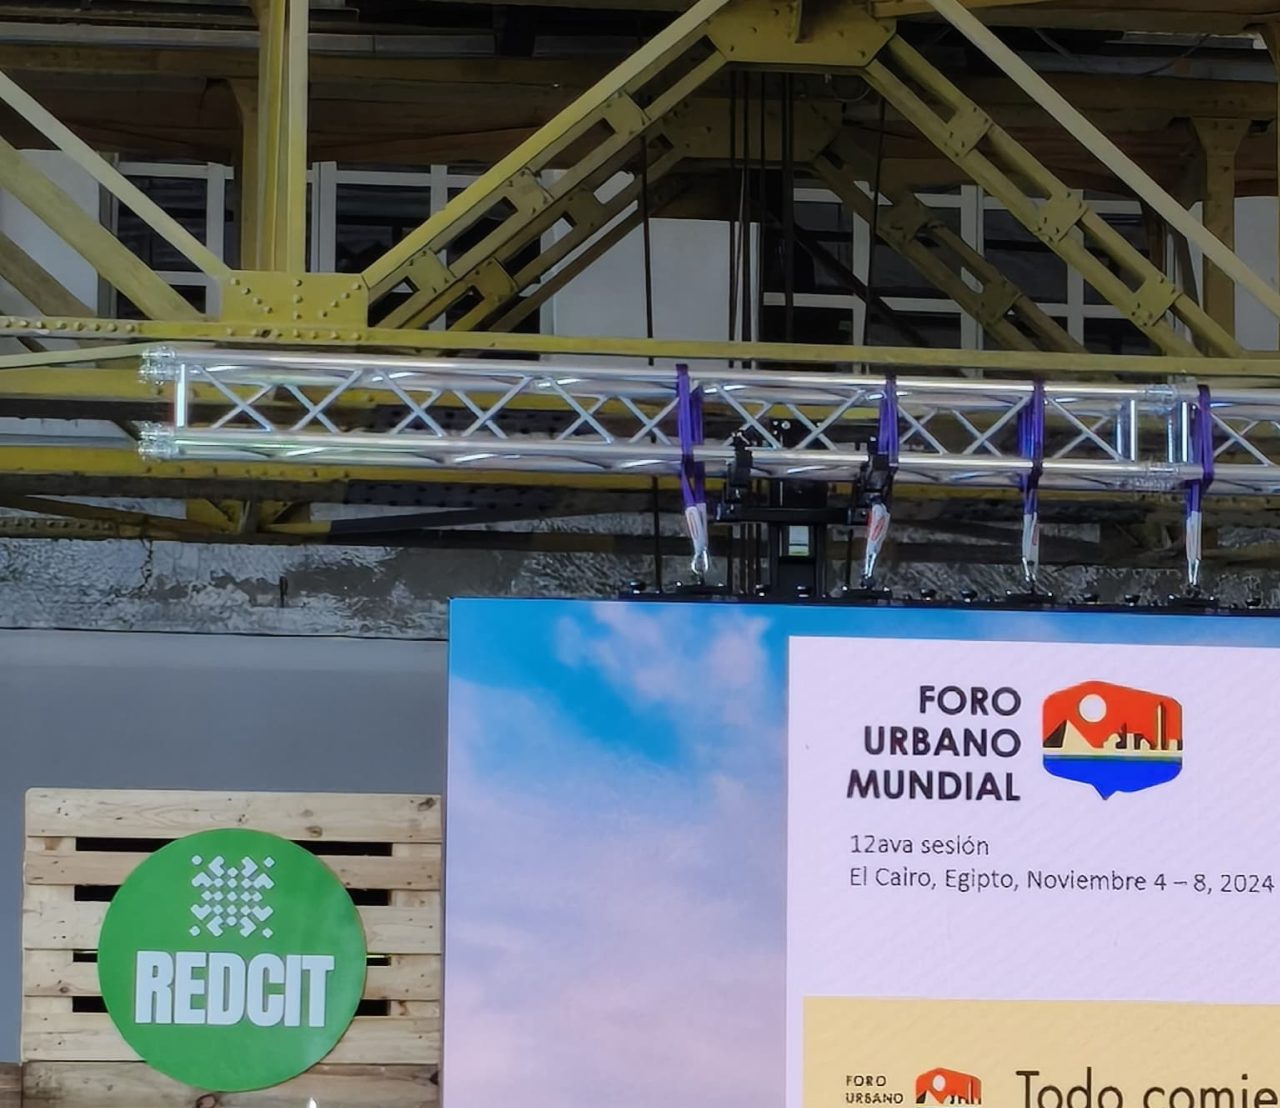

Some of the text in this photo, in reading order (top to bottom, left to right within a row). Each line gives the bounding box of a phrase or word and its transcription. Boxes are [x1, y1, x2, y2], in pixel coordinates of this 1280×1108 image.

[919, 685, 1022, 717] FORO
[864, 725, 1022, 758] URBANO
[846, 768, 1021, 802] MUNDIAL
[850, 834, 989, 856] 12ava sesión
[850, 865, 867, 886] El
[875, 866, 937, 890] Cairo,
[945, 868, 1019, 893] Egipto,
[1027, 869, 1147, 891] Noviembre
[1153, 873, 1167, 891] 4
[1193, 873, 1213, 895] 8,
[1220, 874, 1275, 893] 2024
[134, 950, 336, 1028] REDCIT
[846, 1075, 887, 1087] FORO
